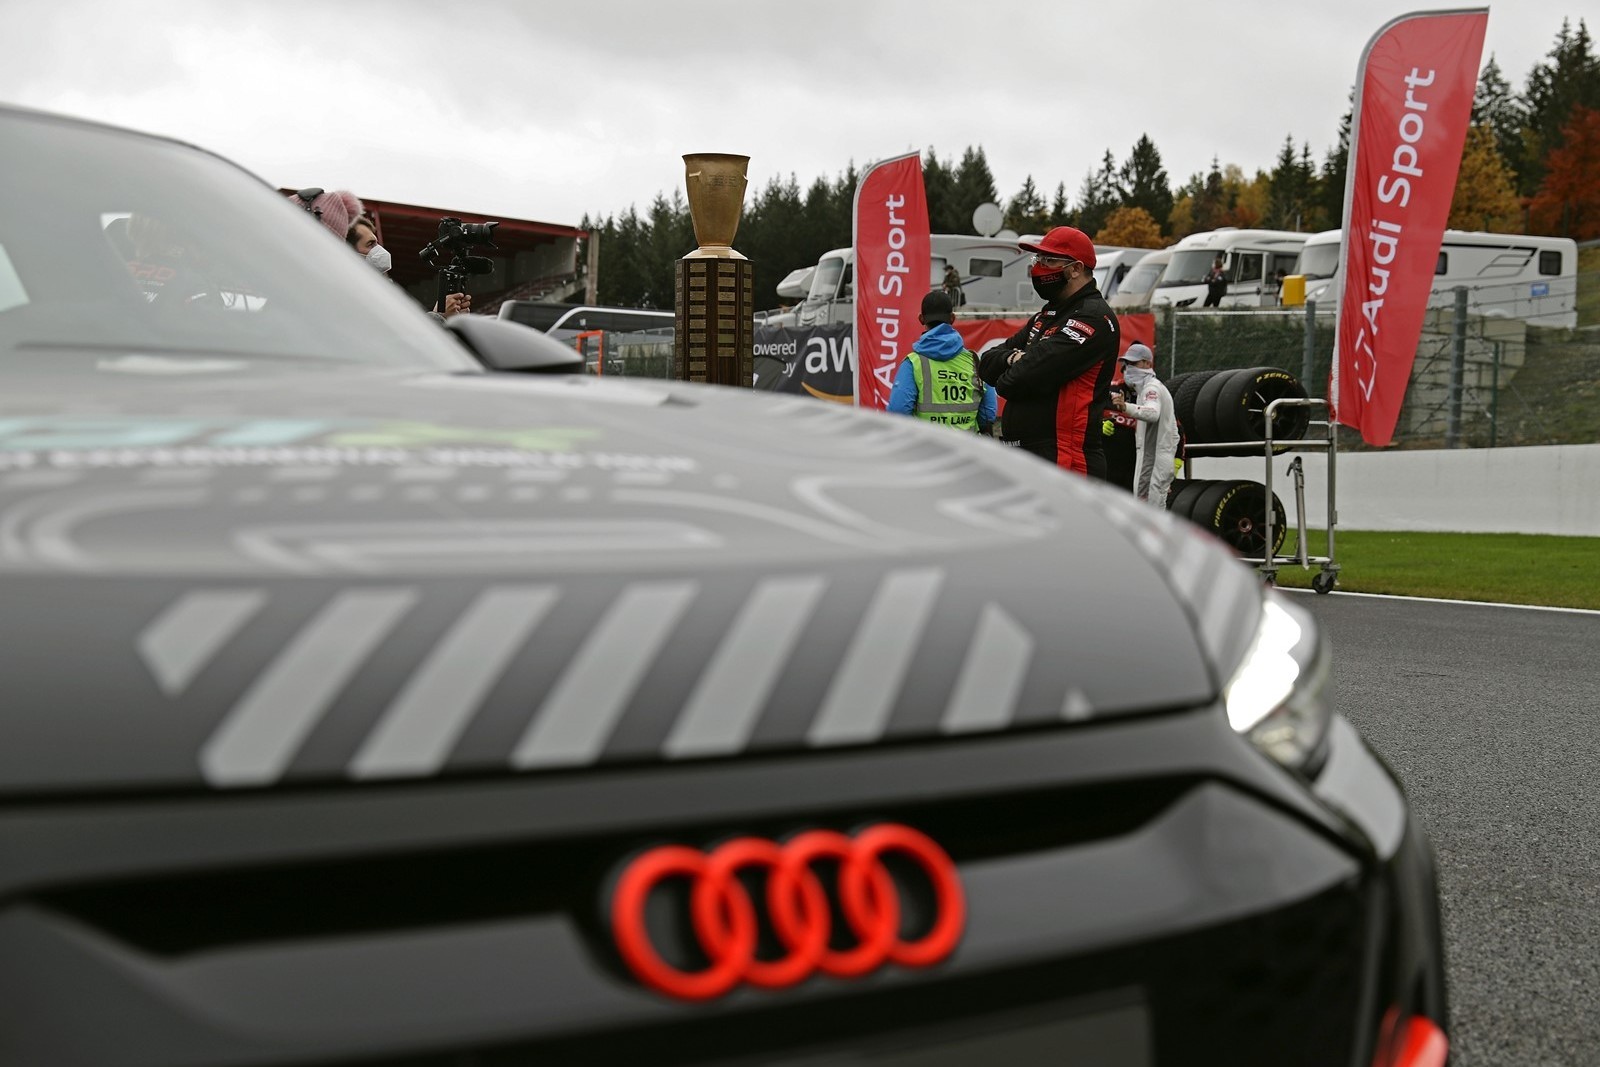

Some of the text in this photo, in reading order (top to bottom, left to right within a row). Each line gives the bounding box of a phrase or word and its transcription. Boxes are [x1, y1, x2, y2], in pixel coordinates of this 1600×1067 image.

[1362, 67, 1436, 336] Audi Sport
[873, 194, 910, 389] Audi Sport
[1061, 326, 1087, 345] SPA
[1074, 321, 1093, 334] TOTAL
[753, 339, 797, 356] owered
[805, 336, 854, 374] aw
[1263, 372, 1290, 380] ZERO
[941, 385, 967, 401] 103
[930, 416, 971, 425] PIT LANE
[1109, 411, 1137, 428] TOT
[1214, 488, 1236, 528] PIRELLI
